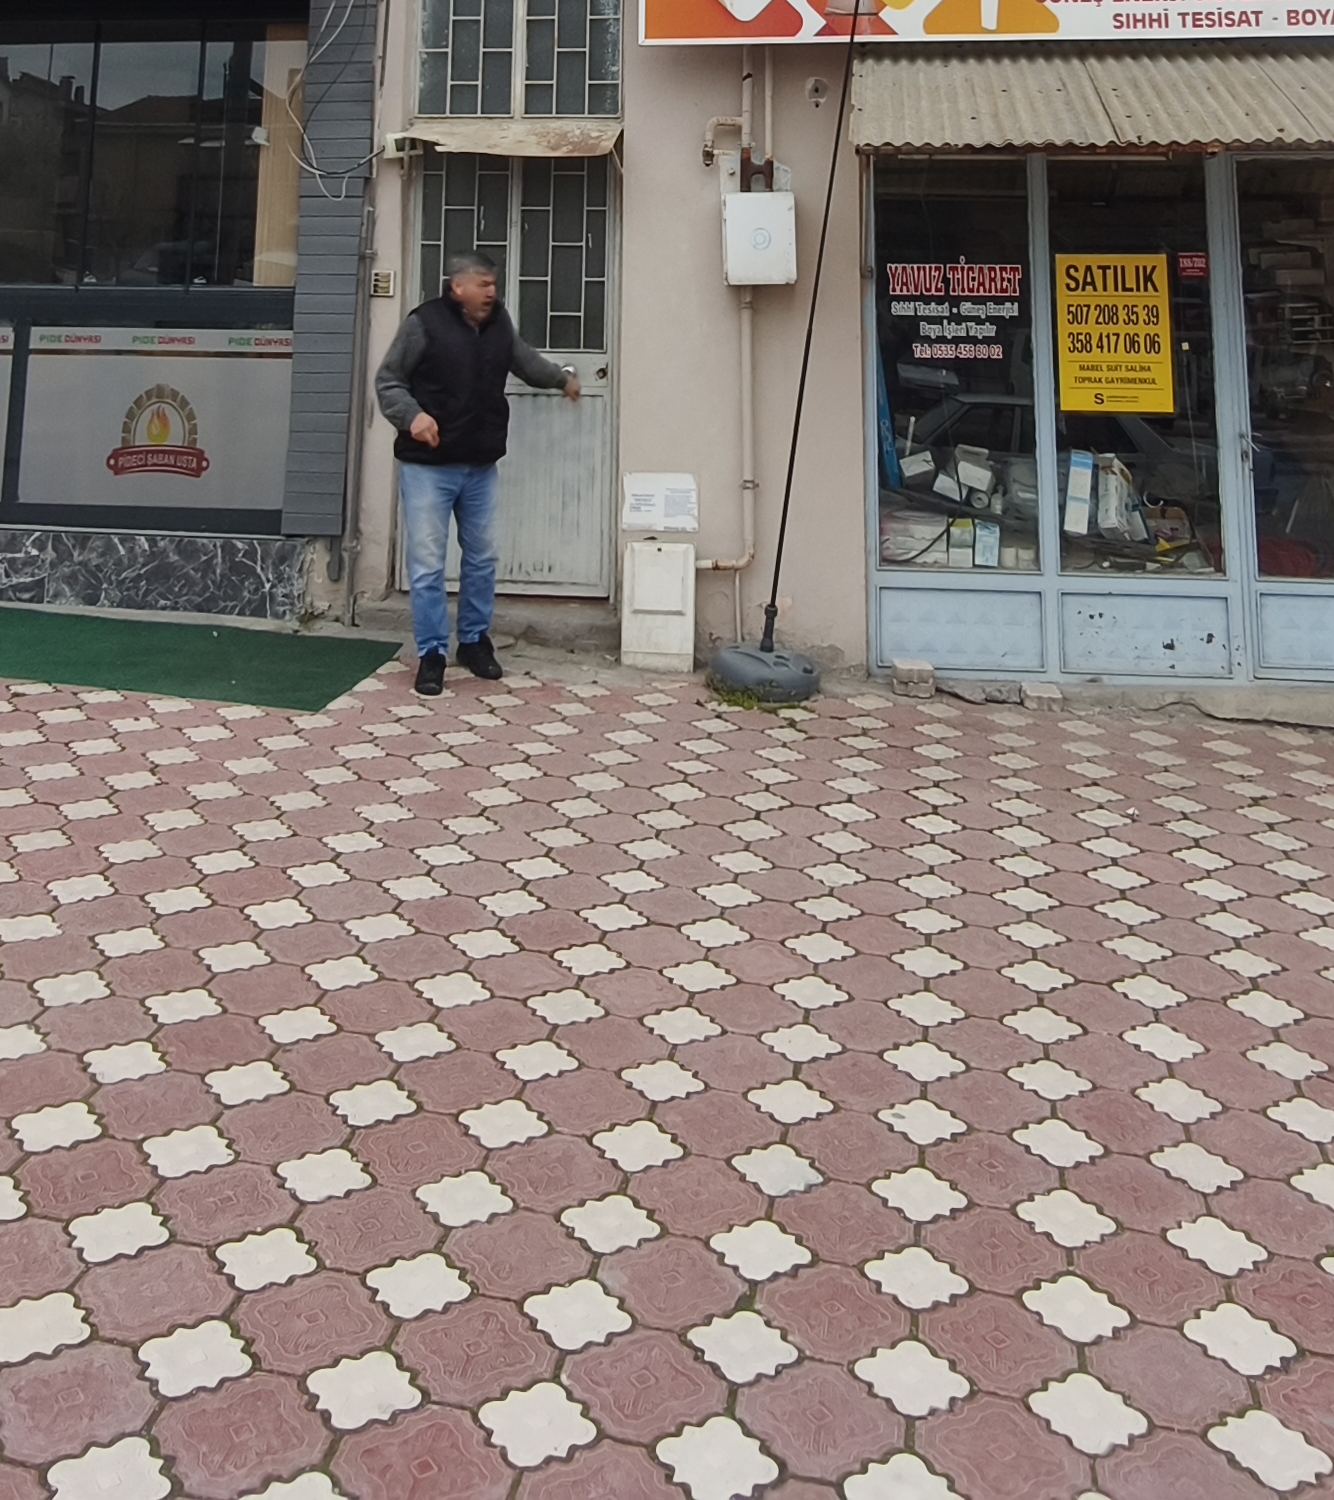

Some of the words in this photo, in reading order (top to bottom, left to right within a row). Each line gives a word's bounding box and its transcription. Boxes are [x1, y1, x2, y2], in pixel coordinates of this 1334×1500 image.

[1113, 8, 1170, 29] SIHHİ
[1181, 6, 1264, 29] TESİSAT
[887, 264, 945, 295] YAVUZ
[947, 256, 1022, 296] TİCARET
[1065, 264, 1159, 293] SATILIK
[1067, 304, 1091, 325] 507
[1094, 304, 1118, 325] 208
[1122, 304, 1139, 326] 35
[1143, 304, 1160, 326] 39
[1068, 332, 1092, 353] 358
[1096, 332, 1120, 353] 417
[1124, 333, 1140, 354] 06
[1144, 333, 1161, 354] 06
